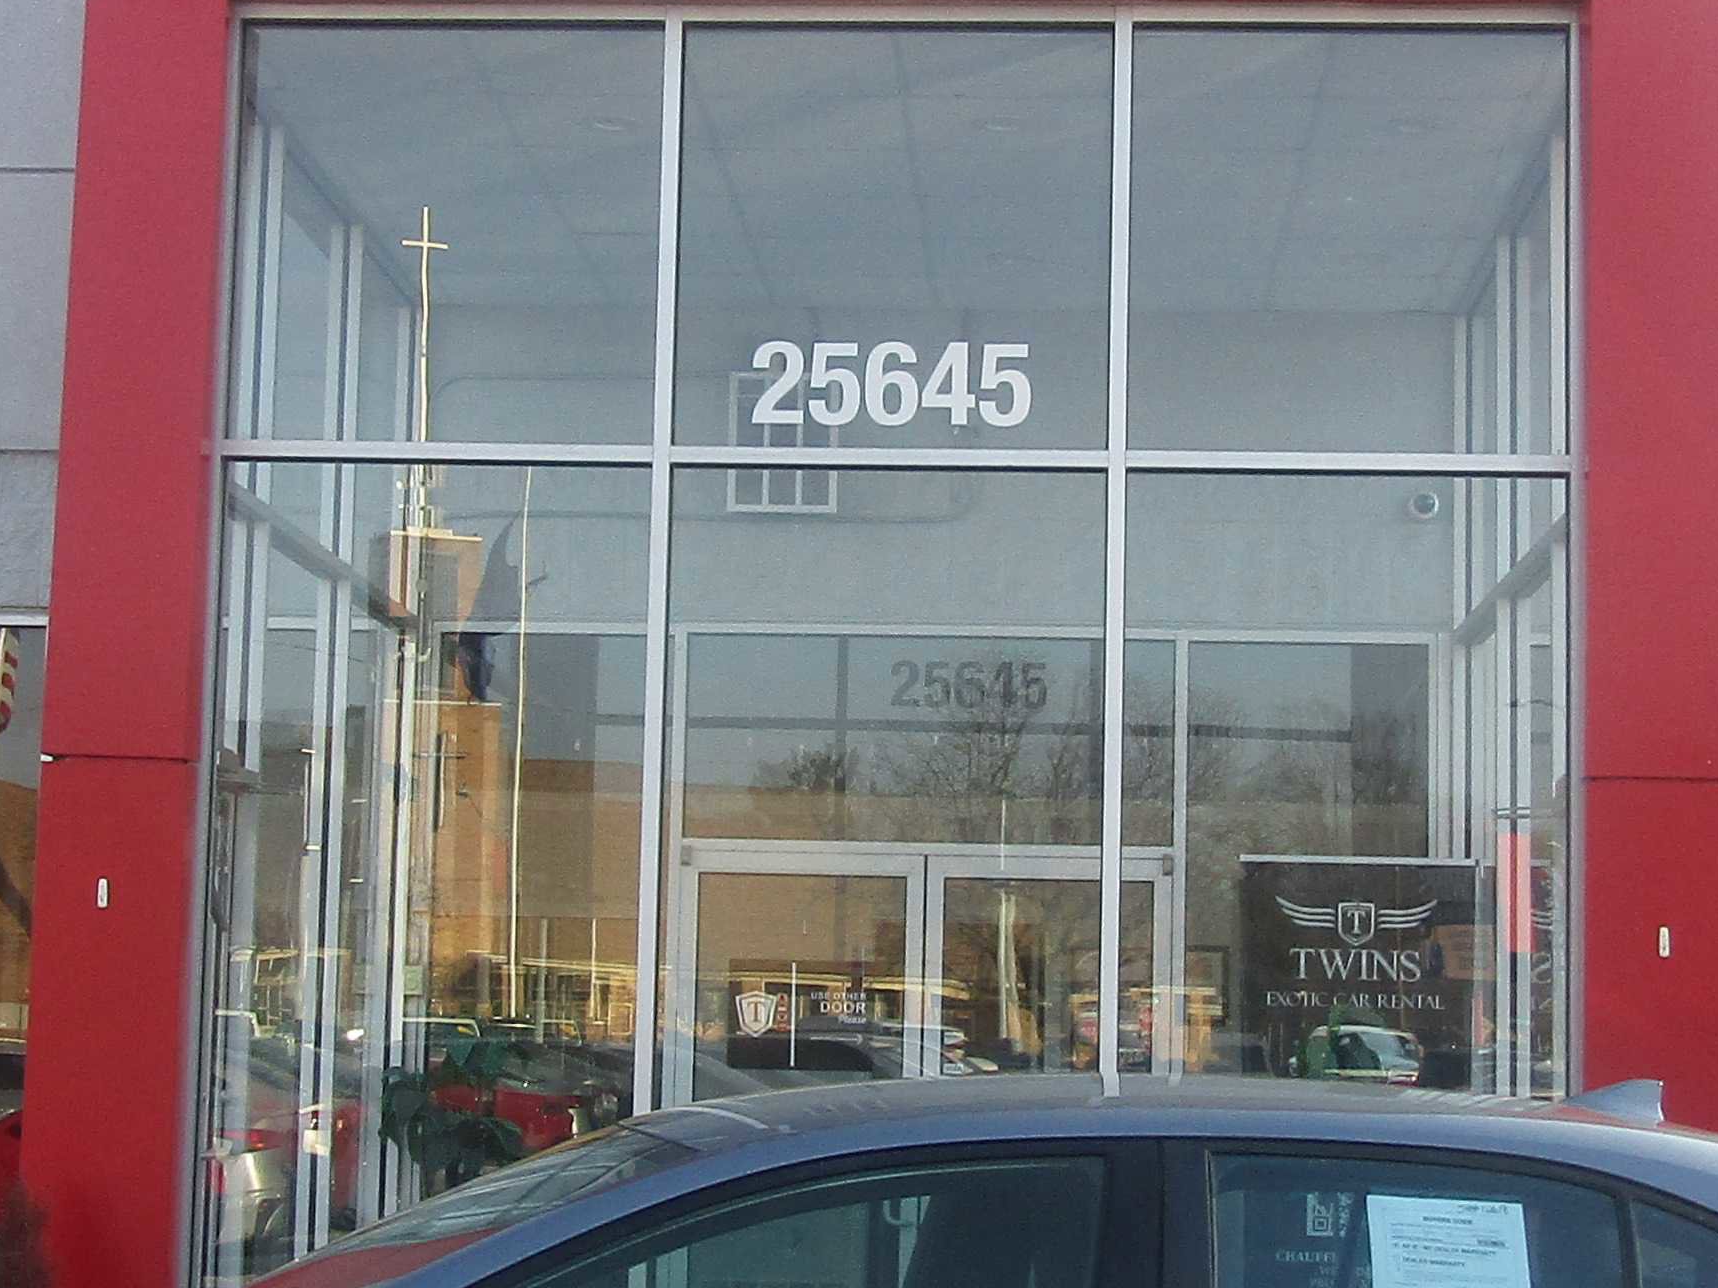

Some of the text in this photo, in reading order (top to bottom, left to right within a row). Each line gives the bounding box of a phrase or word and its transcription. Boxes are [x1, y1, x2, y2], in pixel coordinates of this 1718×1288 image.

[751, 341, 1030, 429] 25645
[891, 660, 1047, 710] 25645
[1347, 909, 1366, 935] T
[1289, 948, 1422, 983] TWINS
[819, 1001, 867, 1014] DOOR
[1266, 991, 1446, 1011] EXOTIC CAR RENTAL
